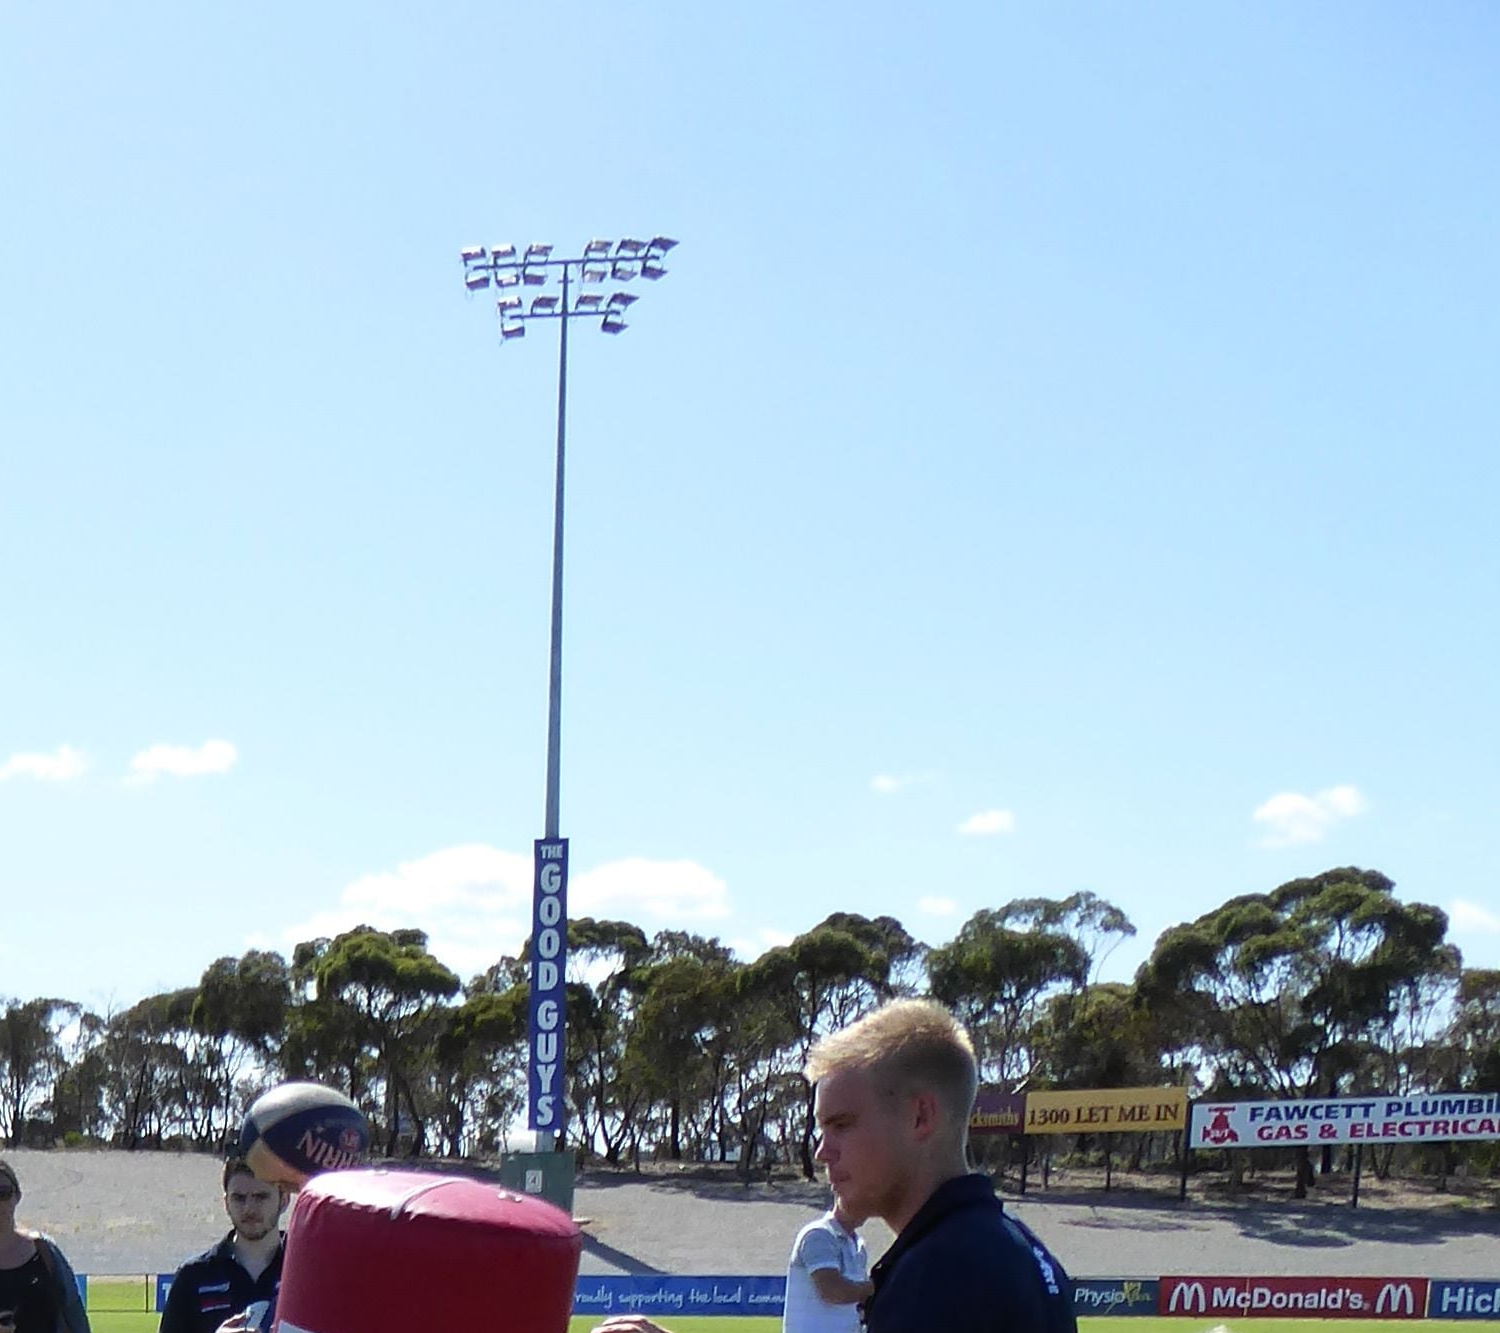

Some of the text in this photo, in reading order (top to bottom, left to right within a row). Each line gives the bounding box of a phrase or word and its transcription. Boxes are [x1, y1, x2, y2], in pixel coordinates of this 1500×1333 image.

[540, 845, 563, 859] THE
[535, 863, 562, 1127] GOOD GUYS
[970, 1105, 1020, 1128] cksmiths
[1028, 1103, 1180, 1126] 1300 LET ME IN
[1250, 1102, 1375, 1122] FAWCETT
[1257, 1118, 1500, 1141] GAS & ELECTRICA
[574, 1285, 613, 1309] roudly
[618, 1287, 684, 1310] supporting
[689, 1287, 712, 1303] the
[713, 1285, 742, 1303] local
[1211, 1286, 1364, 1310] McDonald's
